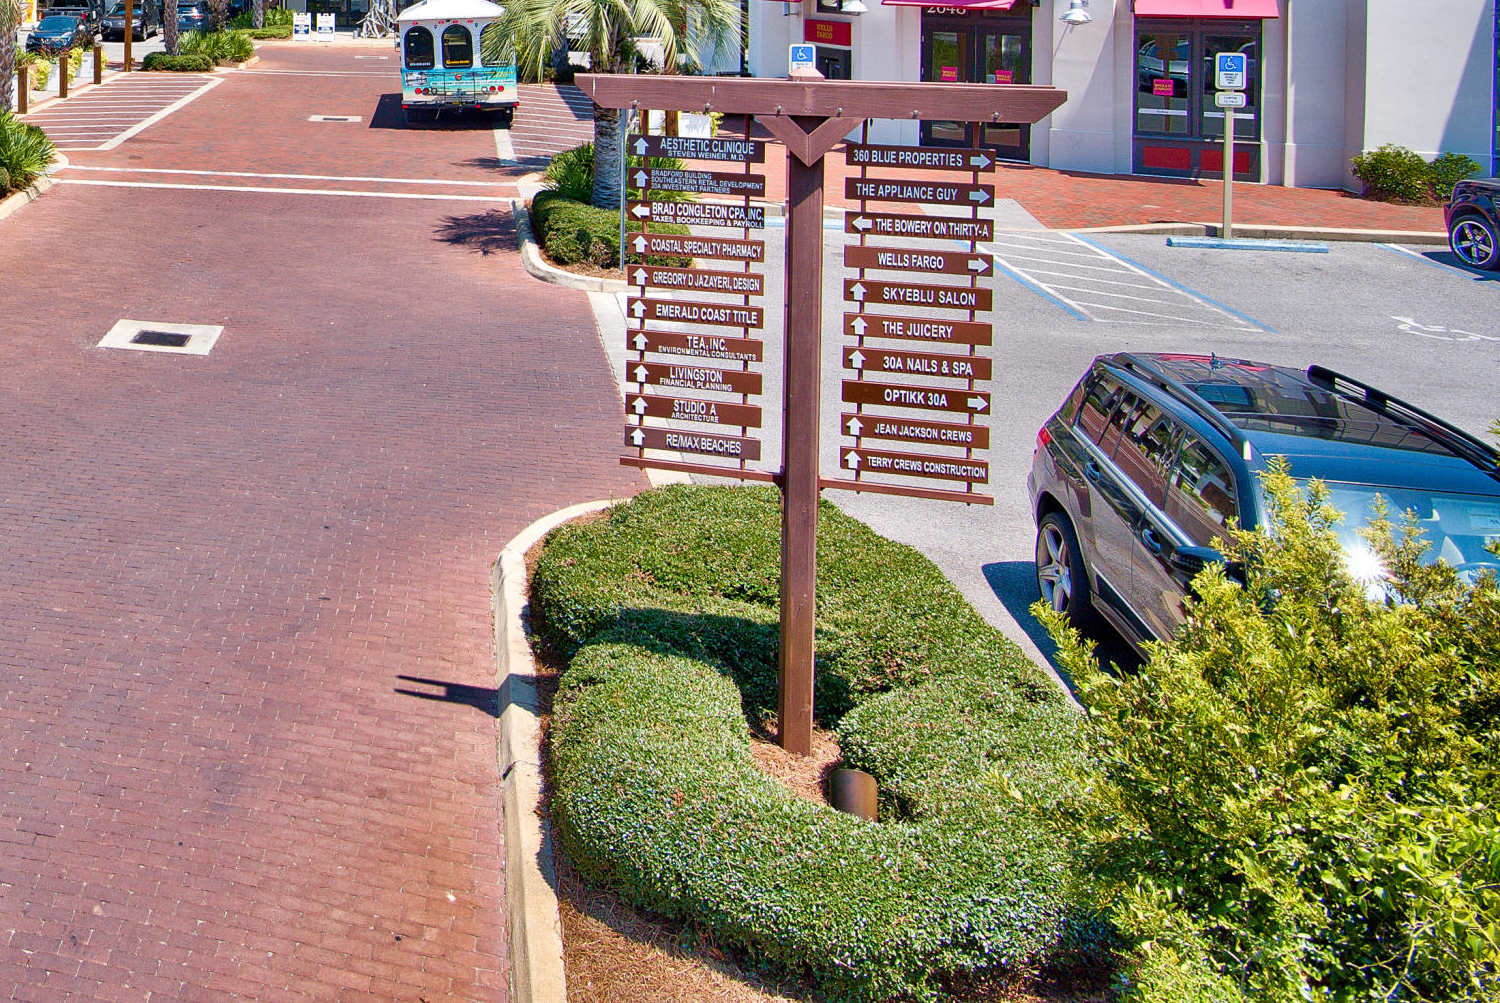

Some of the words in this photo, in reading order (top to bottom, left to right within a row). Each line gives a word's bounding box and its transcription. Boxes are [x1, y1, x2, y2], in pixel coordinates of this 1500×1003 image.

[660, 138, 711, 152] AESTHETIC
[712, 140, 754, 155] CLINIQUE
[668, 150, 696, 158] STEVEN
[730, 153, 746, 161] M.D.
[853, 150, 870, 162] 360
[871, 150, 896, 163] BLUE
[898, 151, 963, 166] PROPERTIES
[651, 169, 683, 178] BRADFORD
[651, 176, 697, 185] SOUTHEASTERN
[698, 179, 718, 187] RETAIL
[720, 181, 763, 189] DEVELOPMENT
[662, 184, 698, 192] INVESTMENT
[700, 186, 731, 194] PARTNERS
[856, 183, 875, 196] THE
[878, 185, 933, 199] APPLIANCE
[936, 188, 958, 200] GUY
[652, 202, 675, 216] BRAD
[677, 204, 728, 218] CONGLETON
[652, 215, 675, 223] TAXES,
[677, 217, 725, 226] BOOKKEEPING
[733, 220, 763, 229] PAYROLL
[876, 219, 892, 231] THE
[894, 219, 932, 234] BOWERY
[934, 222, 947, 234] ON
[948, 223, 989, 237] THIRTY-A
[651, 239, 682, 252] COASTAL
[684, 241, 721, 255] SPECIALTY
[723, 243, 762, 258] PHARMACY
[878, 252, 909, 267] WELLS
[911, 255, 944, 269] FARGO
[653, 271, 686, 285] GREGORY
[688, 273, 693, 286] D
[733, 278, 760, 291] DESIGN
[883, 287, 934, 303] SKYEBLU
[938, 291, 976, 306] SALON
[656, 304, 698, 319] EMERALD
[701, 308, 731, 321] COAST
[733, 310, 757, 324] TITLE
[883, 321, 903, 334] THE
[907, 323, 953, 338] JUICERY
[658, 346, 710, 357] ENVIRONMENTAL
[712, 351, 756, 361] CONSULTANTS
[670, 366, 723, 383] LIVINGSTON
[883, 356, 903, 370] 30A
[906, 358, 938, 373] NAILS
[941, 361, 949, 373] &
[952, 362, 973, 376] SPA
[660, 378, 695, 388] FINANCIAL
[697, 381, 732, 392] PLANNING
[884, 389, 926, 404] OPTIKK
[927, 393, 948, 407] 30A
[674, 400, 706, 414] STUDIO
[710, 404, 717, 415] A
[671, 413, 719, 423] ARCHITECTURE
[874, 423, 897, 435] JEAN
[898, 425, 938, 438] JACKSON
[940, 430, 972, 442] CREWS
[666, 434, 700, 449] RE/MAX
[701, 438, 741, 454] BEACHES
[867, 456, 892, 468] TERRY
[894, 458, 922, 471] CREWS
[924, 462, 986, 478] CONSTRUCTION
